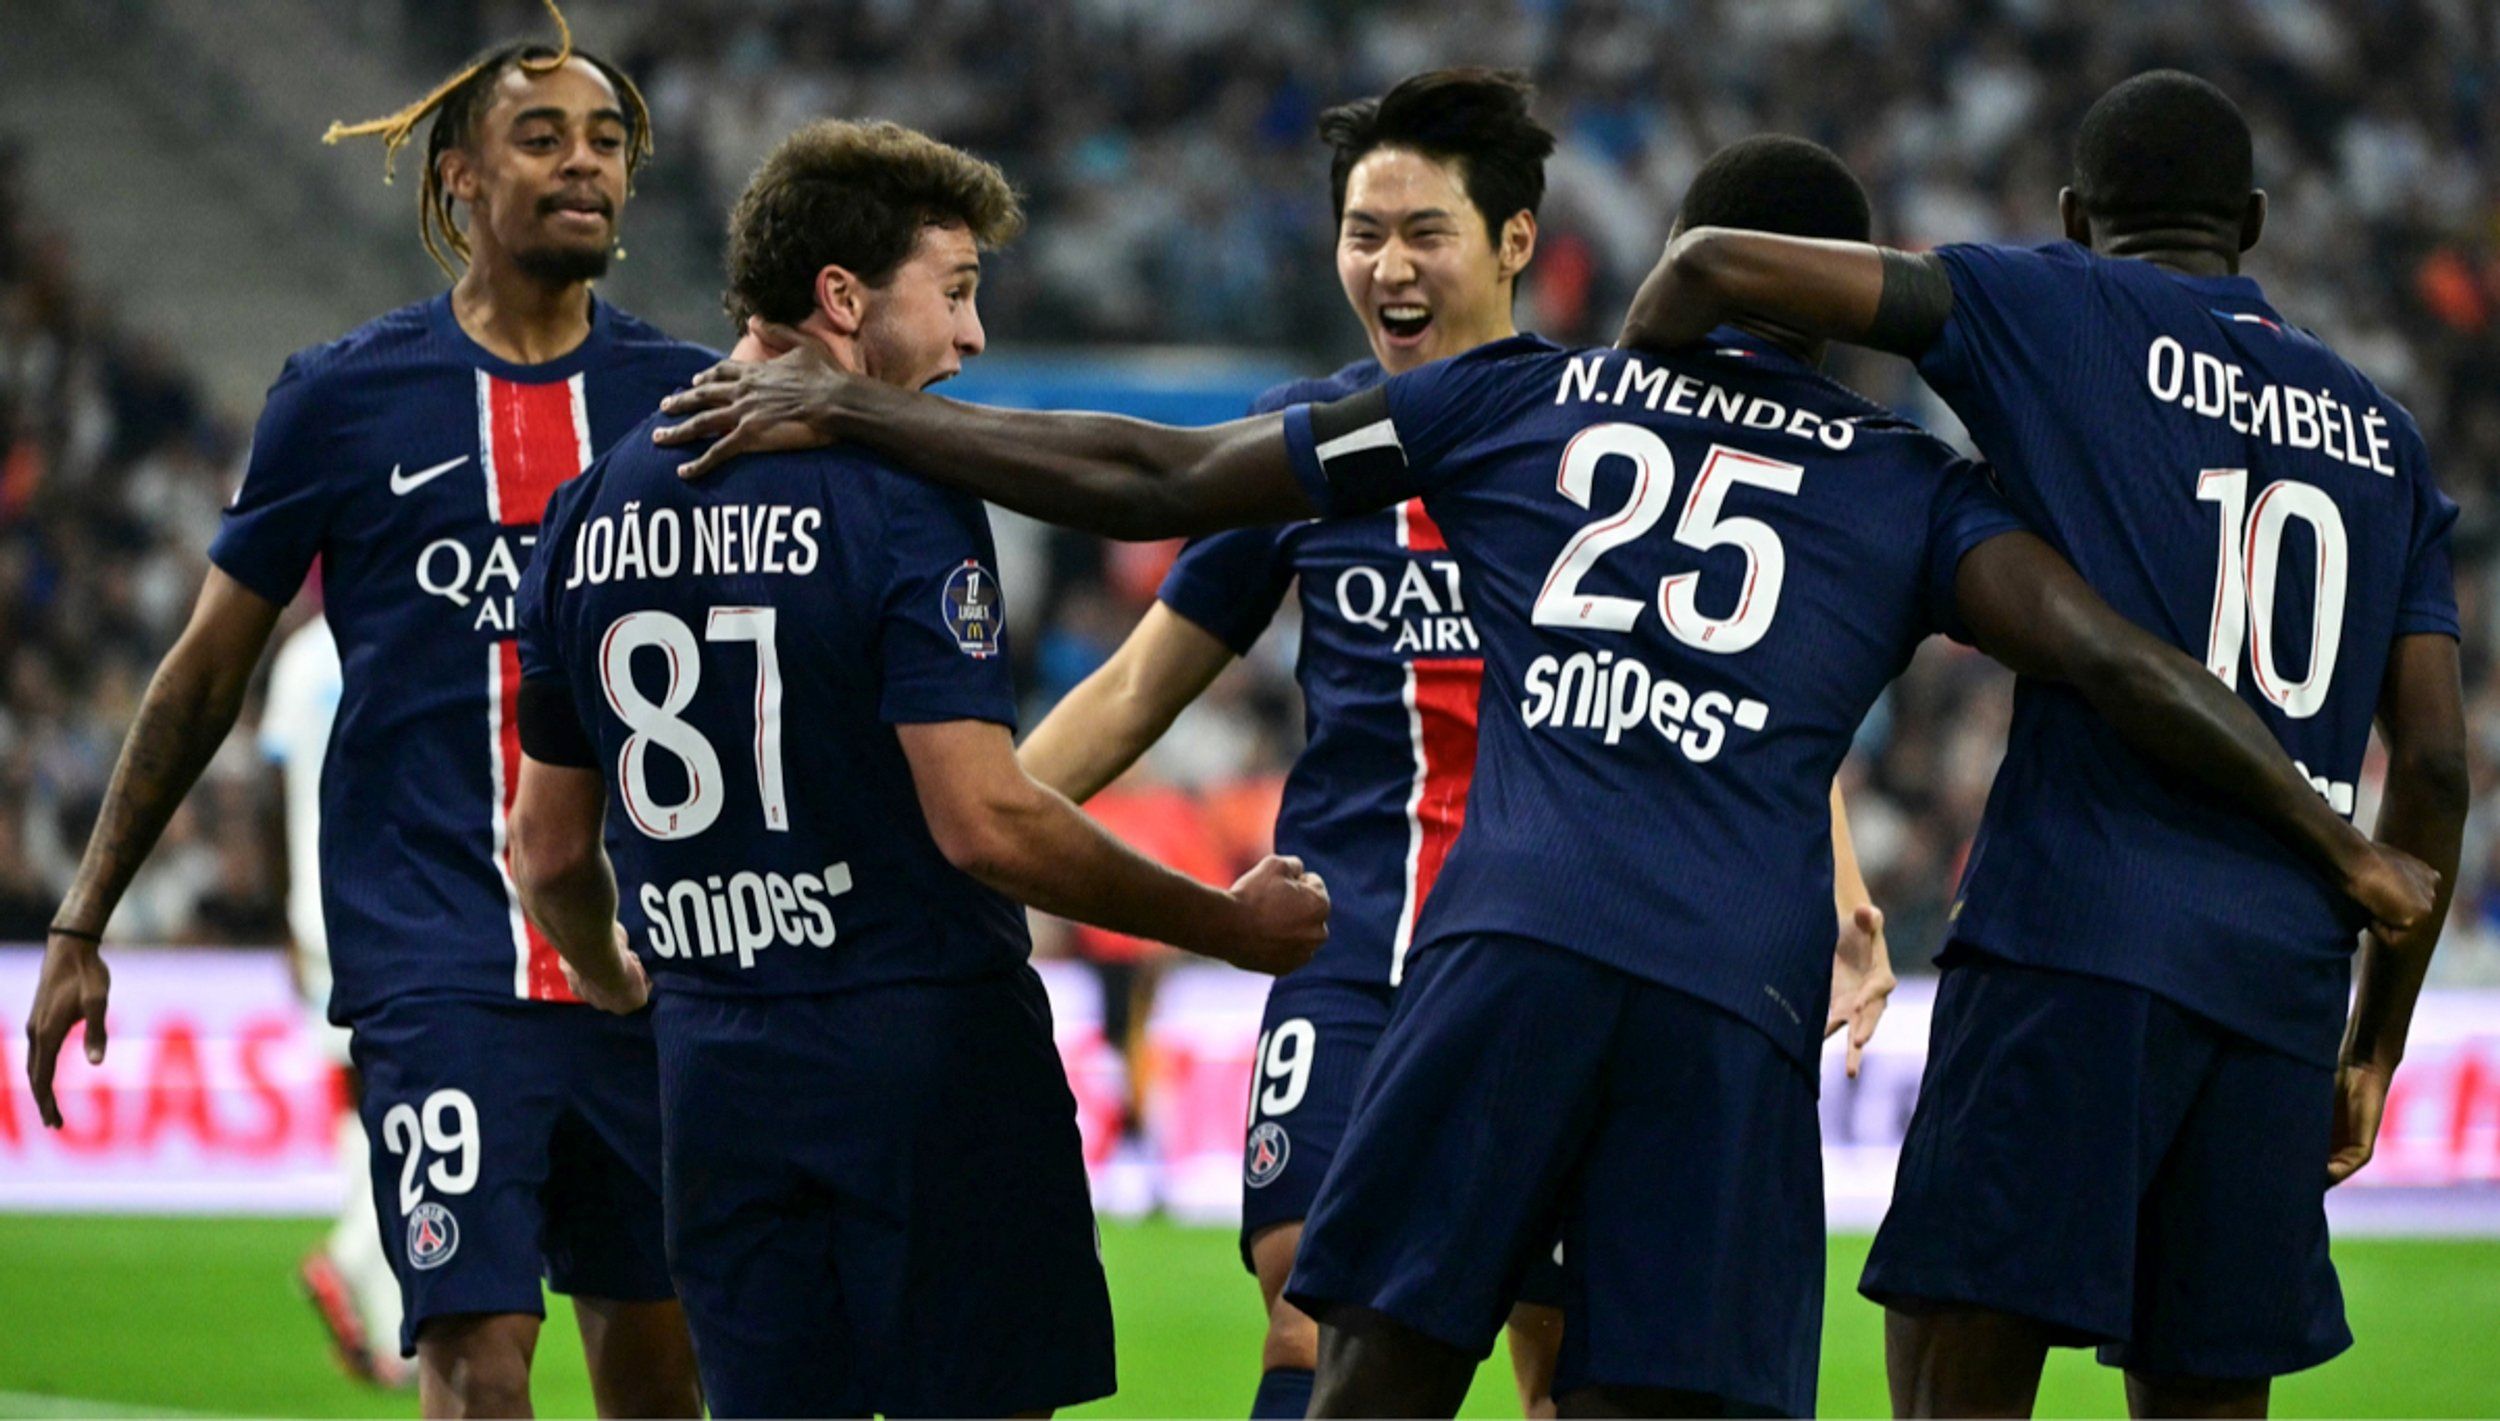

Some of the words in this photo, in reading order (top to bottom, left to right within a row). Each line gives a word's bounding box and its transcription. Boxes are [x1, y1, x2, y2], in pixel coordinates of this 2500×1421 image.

[2147, 335, 2395, 477] O.DEMBÉLÉ
[565, 500, 680, 590] JOÃO
[692, 505, 822, 575] NEVES
[1531, 422, 1805, 655] 25
[2196, 467, 2348, 719] 10
[598, 606, 789, 841] 87
[1521, 650, 1735, 763] snipes
[640, 870, 836, 969] snipes
[383, 1088, 480, 1216] 29
